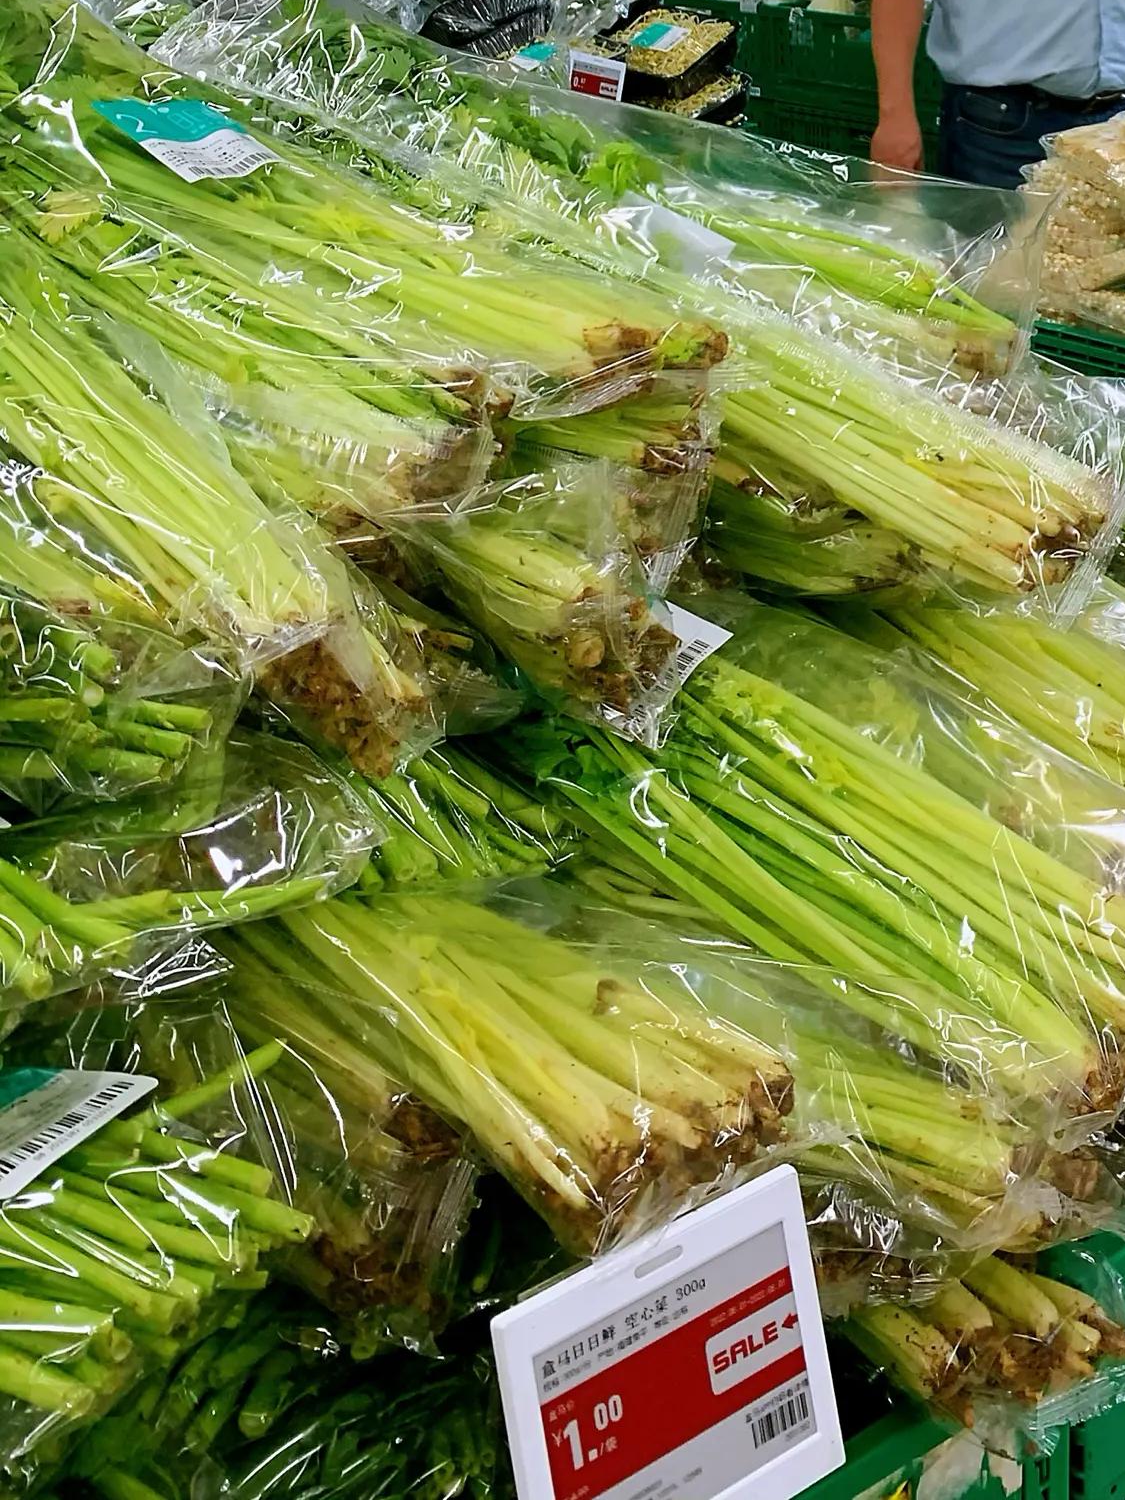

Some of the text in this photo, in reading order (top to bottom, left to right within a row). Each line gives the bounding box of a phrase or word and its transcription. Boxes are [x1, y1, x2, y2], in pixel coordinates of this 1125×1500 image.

[540, 1324, 617, 1380] 盒马日日鲜
[624, 1293, 669, 1332] 空心菜
[675, 1277, 707, 1302] 300g
[711, 1320, 779, 1376] SALE
